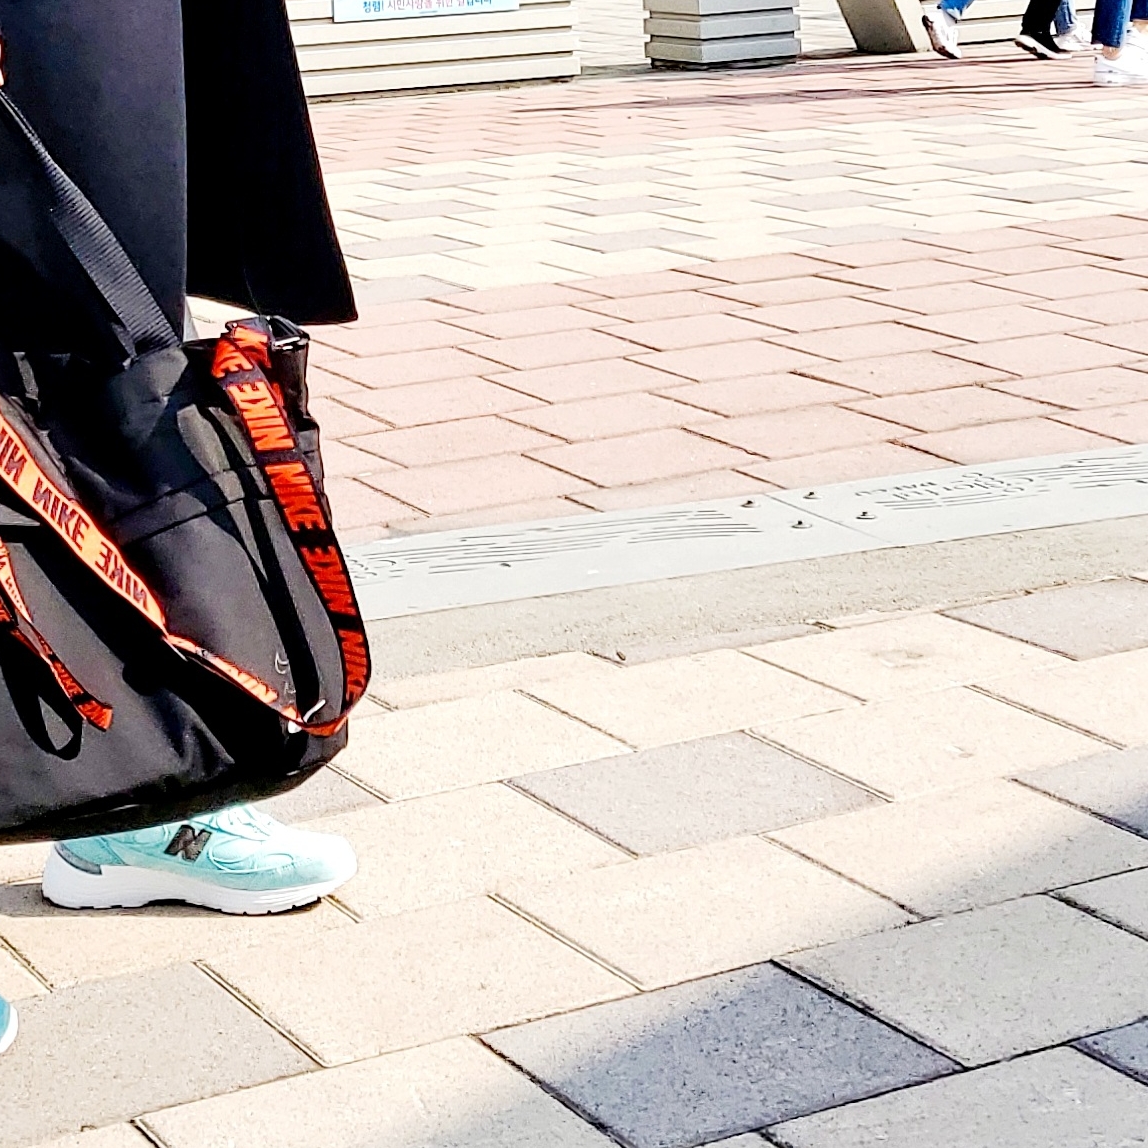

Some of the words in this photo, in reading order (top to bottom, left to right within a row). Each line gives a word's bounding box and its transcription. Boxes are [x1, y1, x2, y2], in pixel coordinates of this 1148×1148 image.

[225, 380, 295, 451] NIKE
[264, 461, 327, 532] NIKE
[299, 546, 357, 617] NIKE
[163, 824, 213, 862] N
